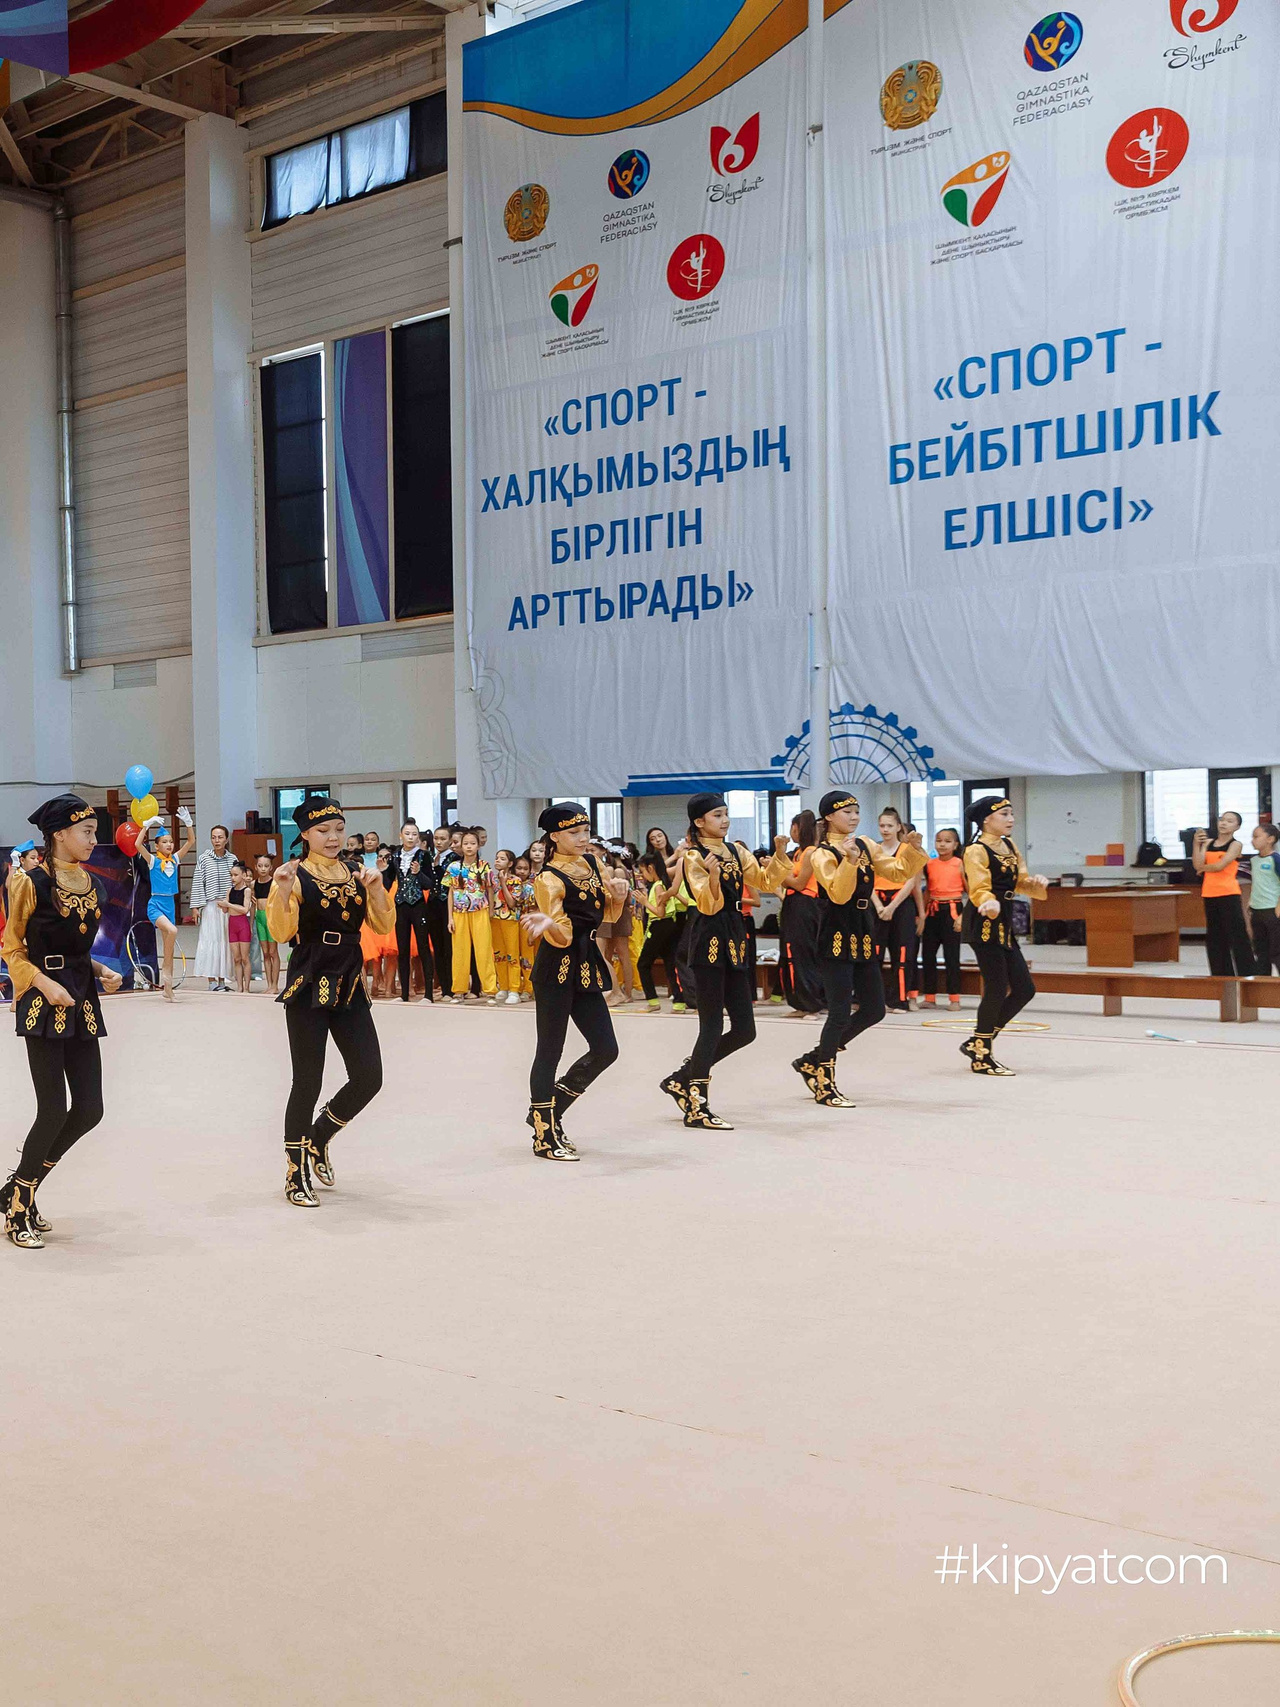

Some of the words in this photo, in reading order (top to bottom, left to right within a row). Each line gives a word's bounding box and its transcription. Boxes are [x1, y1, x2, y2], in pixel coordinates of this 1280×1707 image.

[1163, 33, 1247, 70] Shymkent
[1016, 72, 1089, 101] QAZAQSTAN
[1016, 85, 1090, 113] GIMNASTIKA
[1012, 96, 1094, 126] FEDERACIASY
[600, 222, 658, 243] FEDERACIASY
[602, 201, 655, 222] QAZAQSTAN
[602, 212, 656, 233] GIMNASTIKA
[933, 327, 1126, 400] «СПОРТ
[544, 377, 681, 436] «СПОРТ
[888, 390, 1222, 485] БЕЙБІТШІЛІК
[481, 425, 790, 512] ХАЛҚЫМЫЗДЫҢ
[551, 507, 702, 565] БІРЛІГІН
[944, 485, 1154, 551] ЕЛШІСІ»
[507, 570, 754, 631] АРТТЫРАДЫ»
